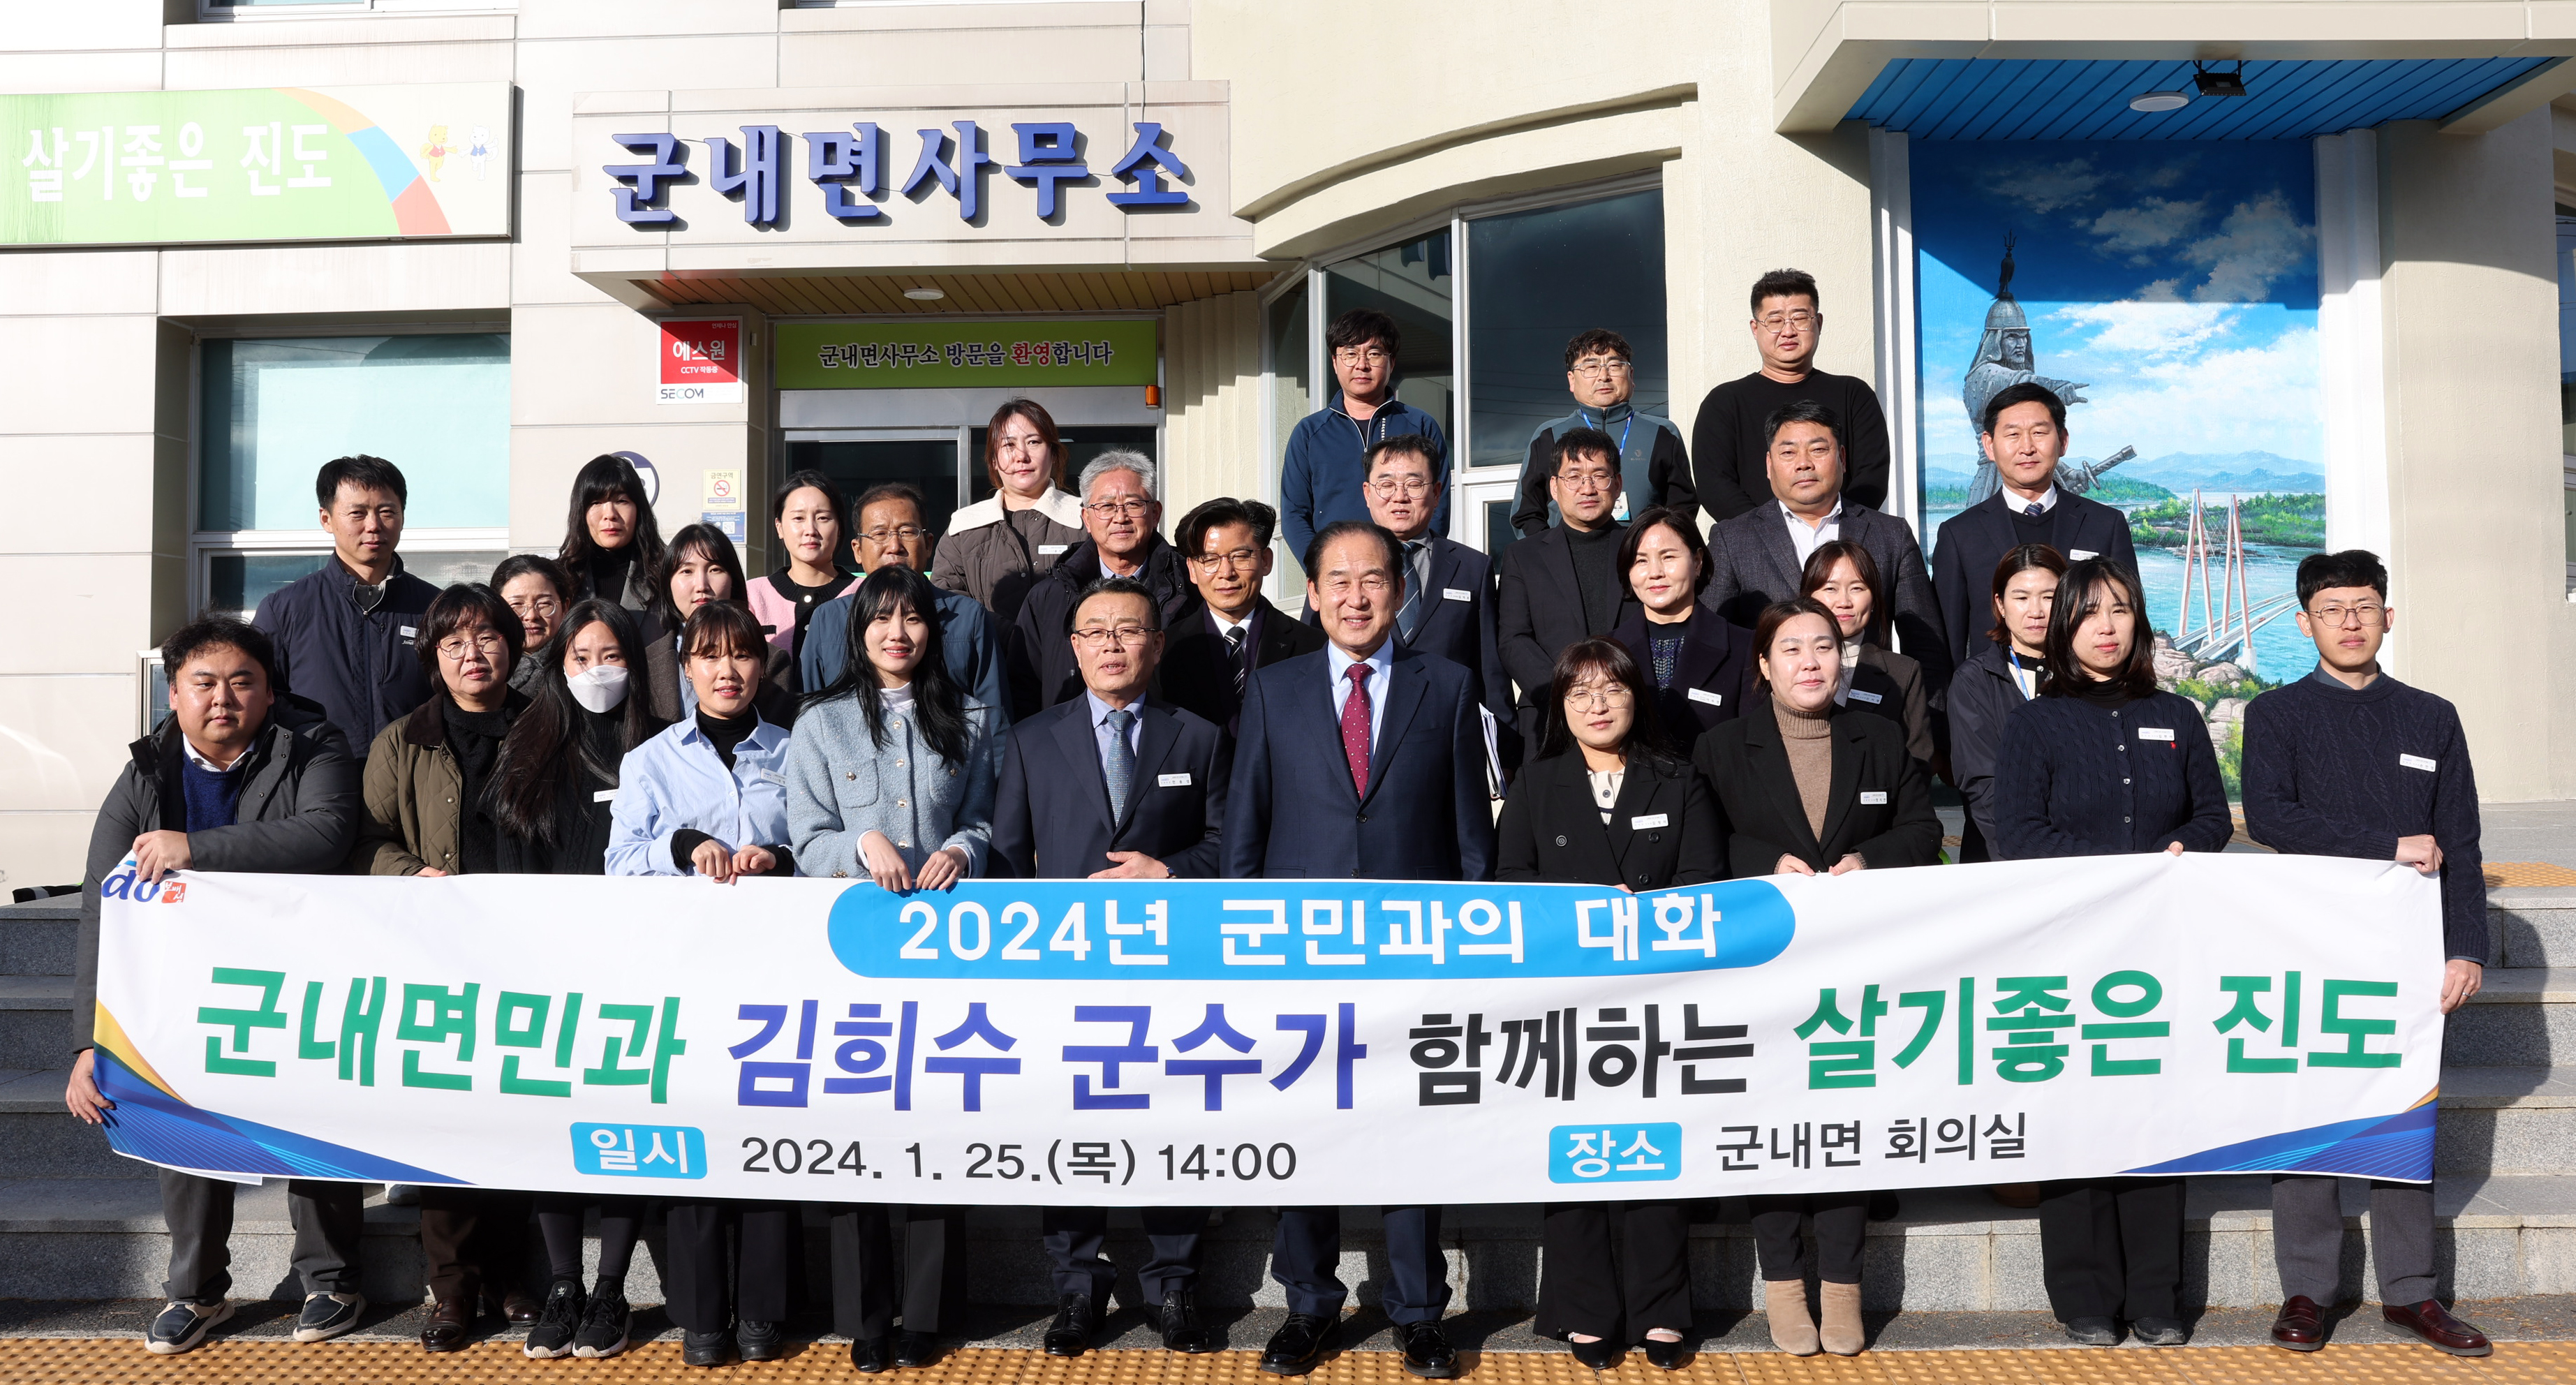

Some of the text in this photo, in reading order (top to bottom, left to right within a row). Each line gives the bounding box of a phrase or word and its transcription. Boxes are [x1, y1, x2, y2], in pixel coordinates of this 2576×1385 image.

[22, 121, 332, 202] 살기좋은 진도
[604, 121, 1190, 222] 군내면사무소
[673, 341, 725, 361] 에스원
[819, 341, 1113, 368] 군내면사무소 방문을 환영합니다
[660, 388, 704, 399] SECOM
[900, 893, 1722, 965] 2024년 군민과의 대화
[198, 967, 2403, 1112] 군내면민과 김희수 군수가 함께하는 살기좋은 진도
[591, 1129, 688, 1174] 일시
[741, 1136, 1297, 1186] 2024. 1. 25.(목) 14:00
[1566, 1130, 1666, 1178] 장소
[1715, 1111, 2026, 1172] 군내면 회의실
